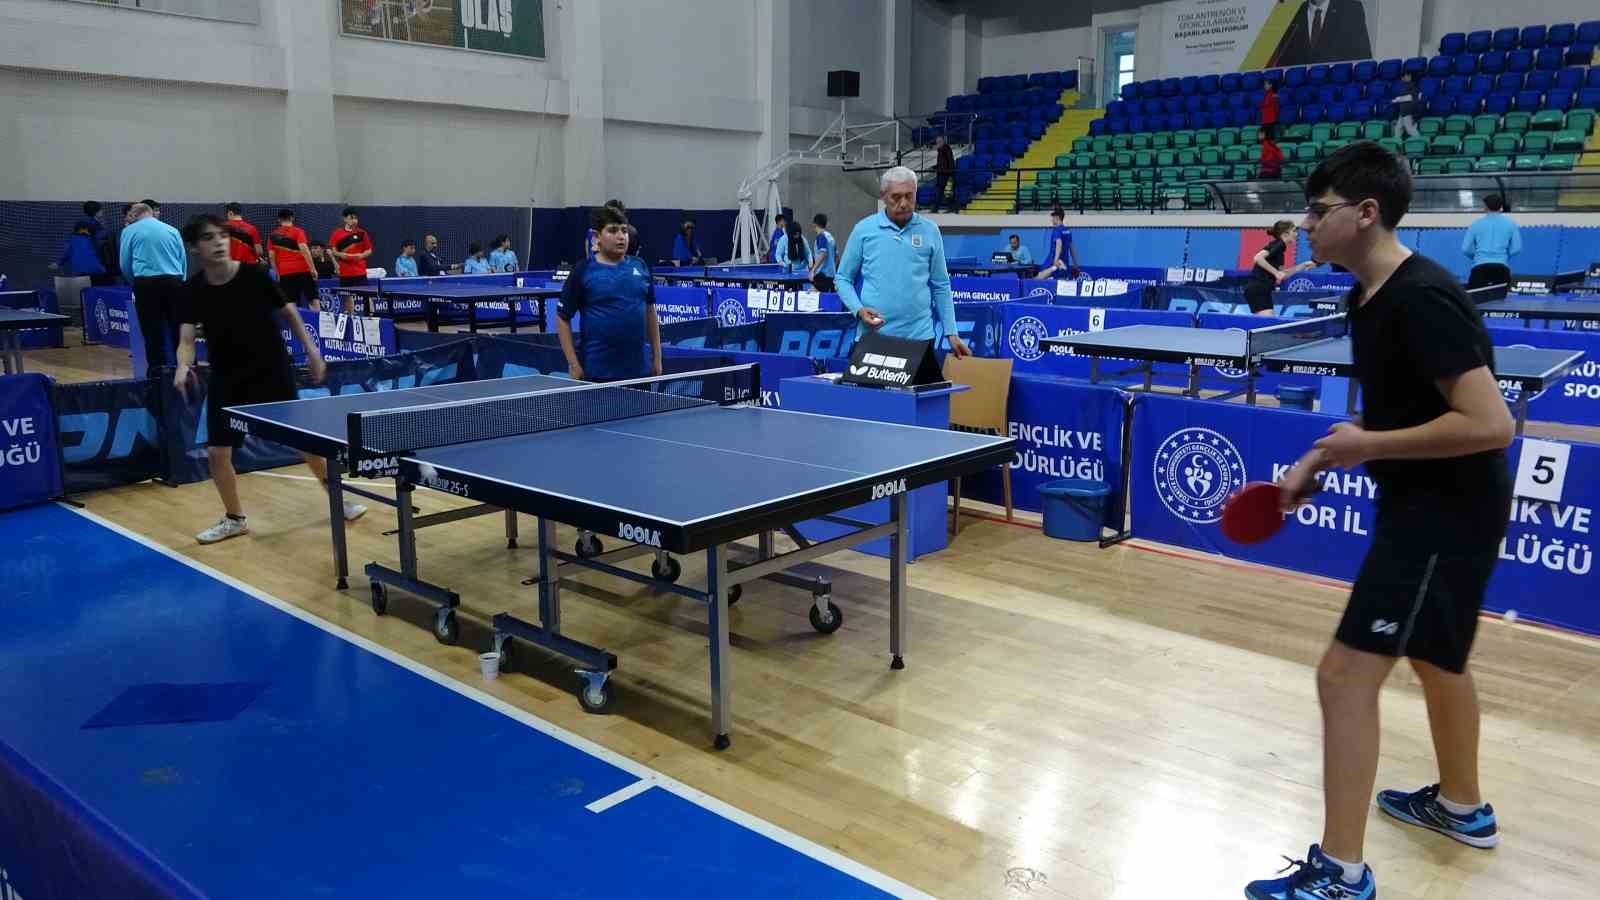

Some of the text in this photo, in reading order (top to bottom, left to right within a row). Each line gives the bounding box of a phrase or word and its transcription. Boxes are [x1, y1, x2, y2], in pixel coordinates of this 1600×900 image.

[1093, 315, 1099, 326] 6
[867, 366, 911, 385] Butterfly
[2, 417, 34, 436] VE
[230, 418, 248, 432] JOOLA
[1076, 431, 1102, 451] VE
[357, 456, 399, 471] JOOLA
[1532, 456, 1556, 485] 5
[871, 477, 908, 499] JOOLA
[1343, 504, 1368, 536] İL
[1550, 503, 1592, 534] VE
[618, 521, 662, 548] JOOLA
[1498, 533, 1592, 575] LÜĞÜ
